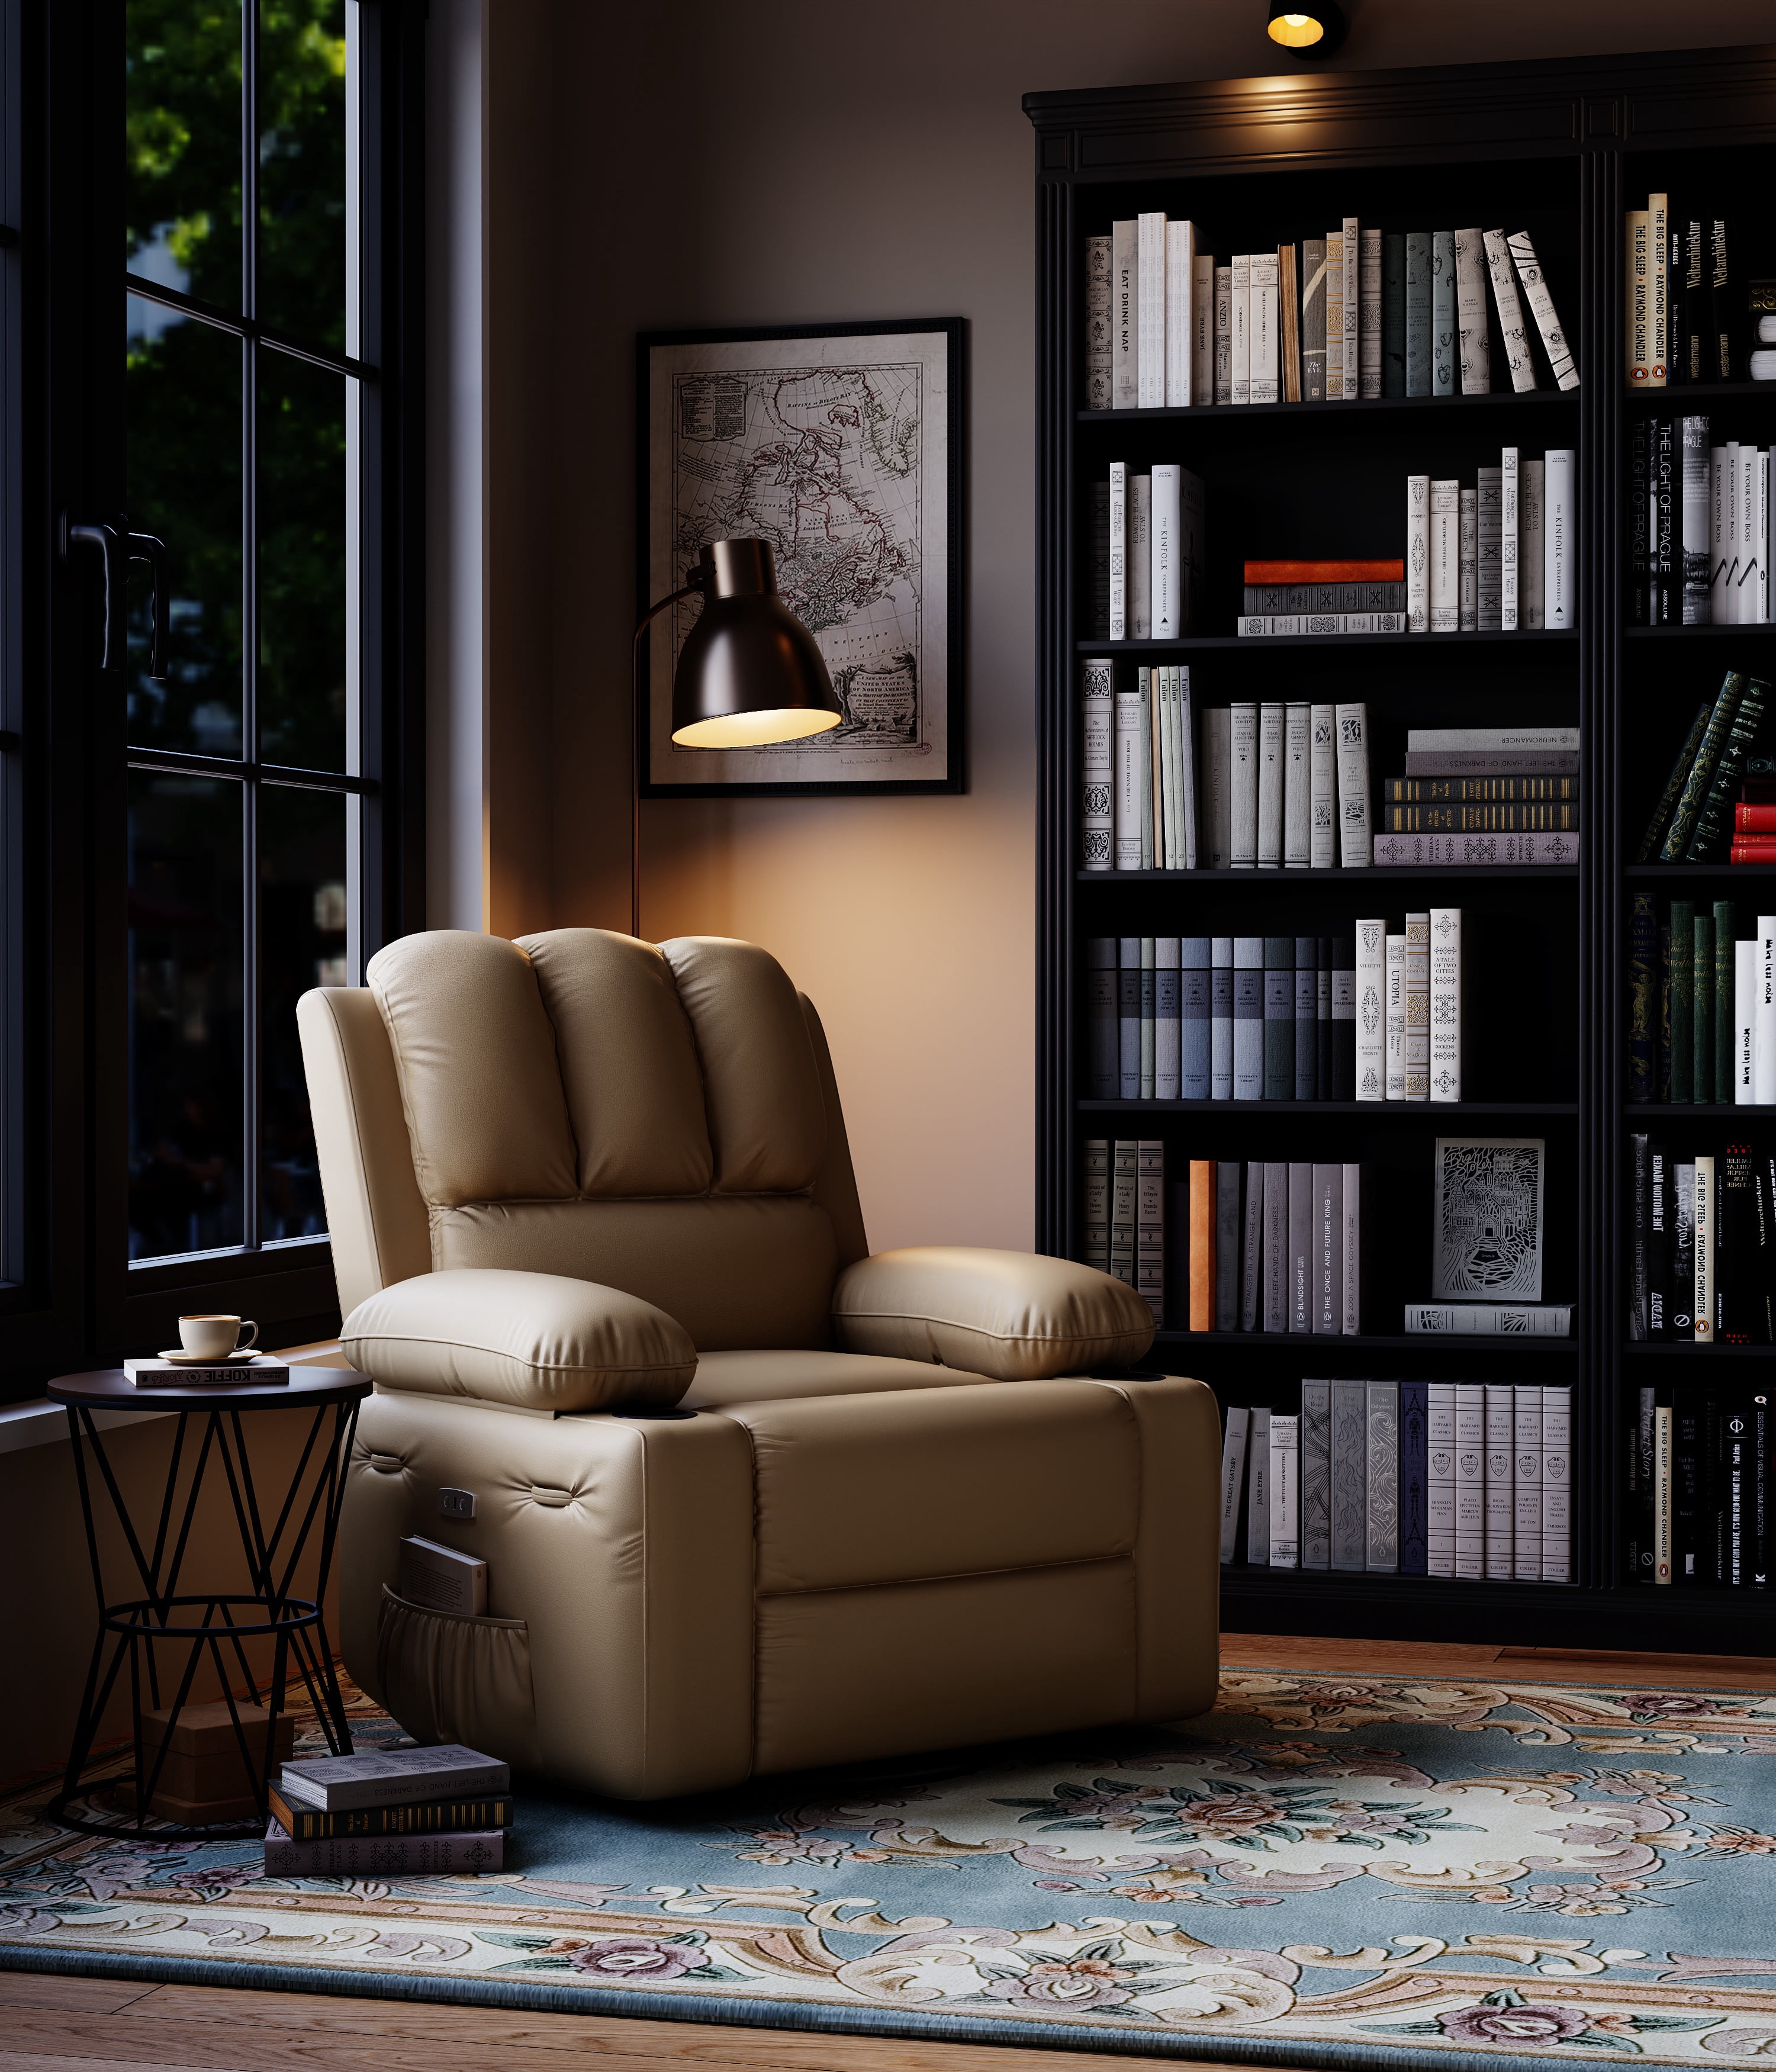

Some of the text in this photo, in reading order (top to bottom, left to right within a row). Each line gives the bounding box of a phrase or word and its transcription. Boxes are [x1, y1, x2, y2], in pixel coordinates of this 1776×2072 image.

[1656, 210, 1664, 223] THE
[1656, 227, 1664, 239] BIG
[1687, 221, 1701, 289] Weltarchitektur
[1711, 220, 1727, 287] Weltarchitektur
[1635, 226, 1646, 362] THE BIG SLEEP RAYMOND CHANDLER
[1656, 275, 1664, 314] RAYMOND
[1691, 335, 1700, 378] westermann
[1719, 334, 1730, 378] westermann
[1745, 463, 1751, 472] BE
[1632, 420, 1645, 571] THE LIGHT OF PRAGUE
[1659, 423, 1671, 572] THE LIGHT OF PRAGUE
[1533, 521, 1539, 530] TO
[1180, 678, 1190, 702] Union
[1273, 1244, 1278, 1254] OF
[204, 1370, 250, 1382] KOFFIE
[1640, 1407, 1654, 1479] Perfect Story
[1757, 1450, 1764, 1459] OF
[374, 1786, 412, 1796] DARKNESS
